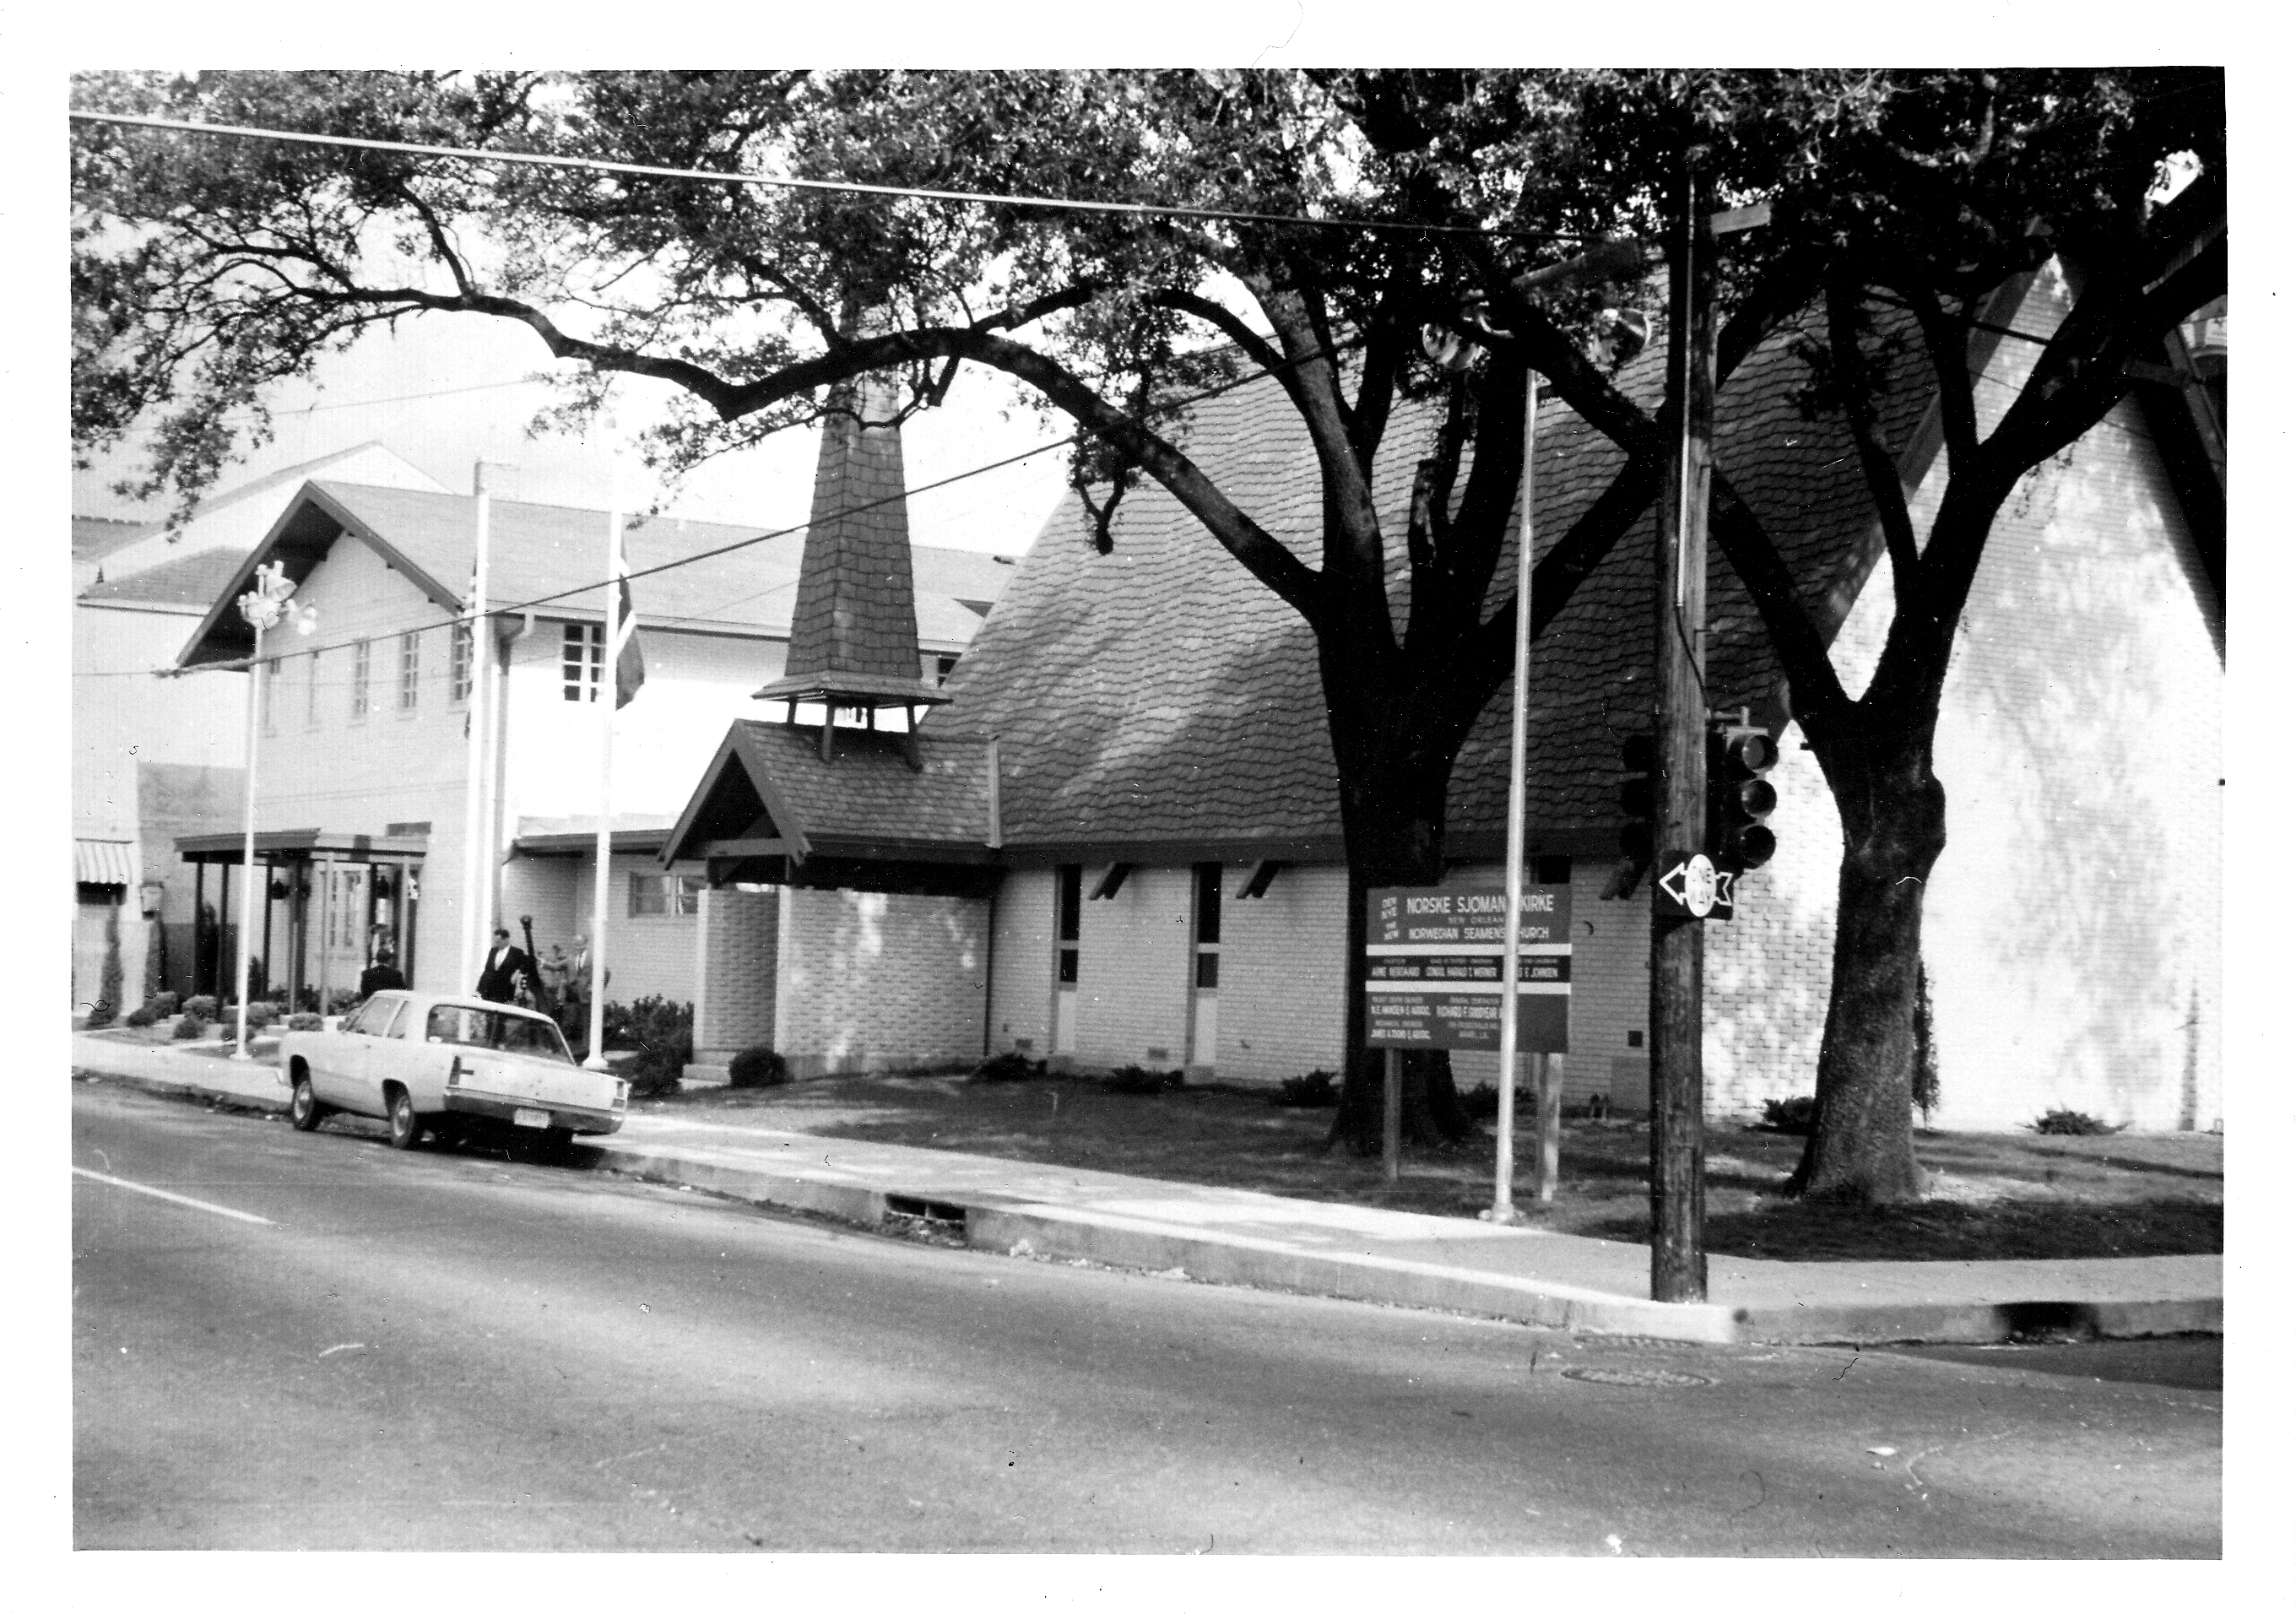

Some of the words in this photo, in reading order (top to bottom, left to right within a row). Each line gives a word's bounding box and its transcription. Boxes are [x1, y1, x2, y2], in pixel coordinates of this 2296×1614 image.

[1407, 896, 1451, 914] NORSKE
[1448, 916, 1465, 924] NEW
[1470, 916, 1505, 924] ORLEAN
[1409, 927, 1459, 940] NORWEGIAN
[1518, 926, 1549, 939] HURCH
